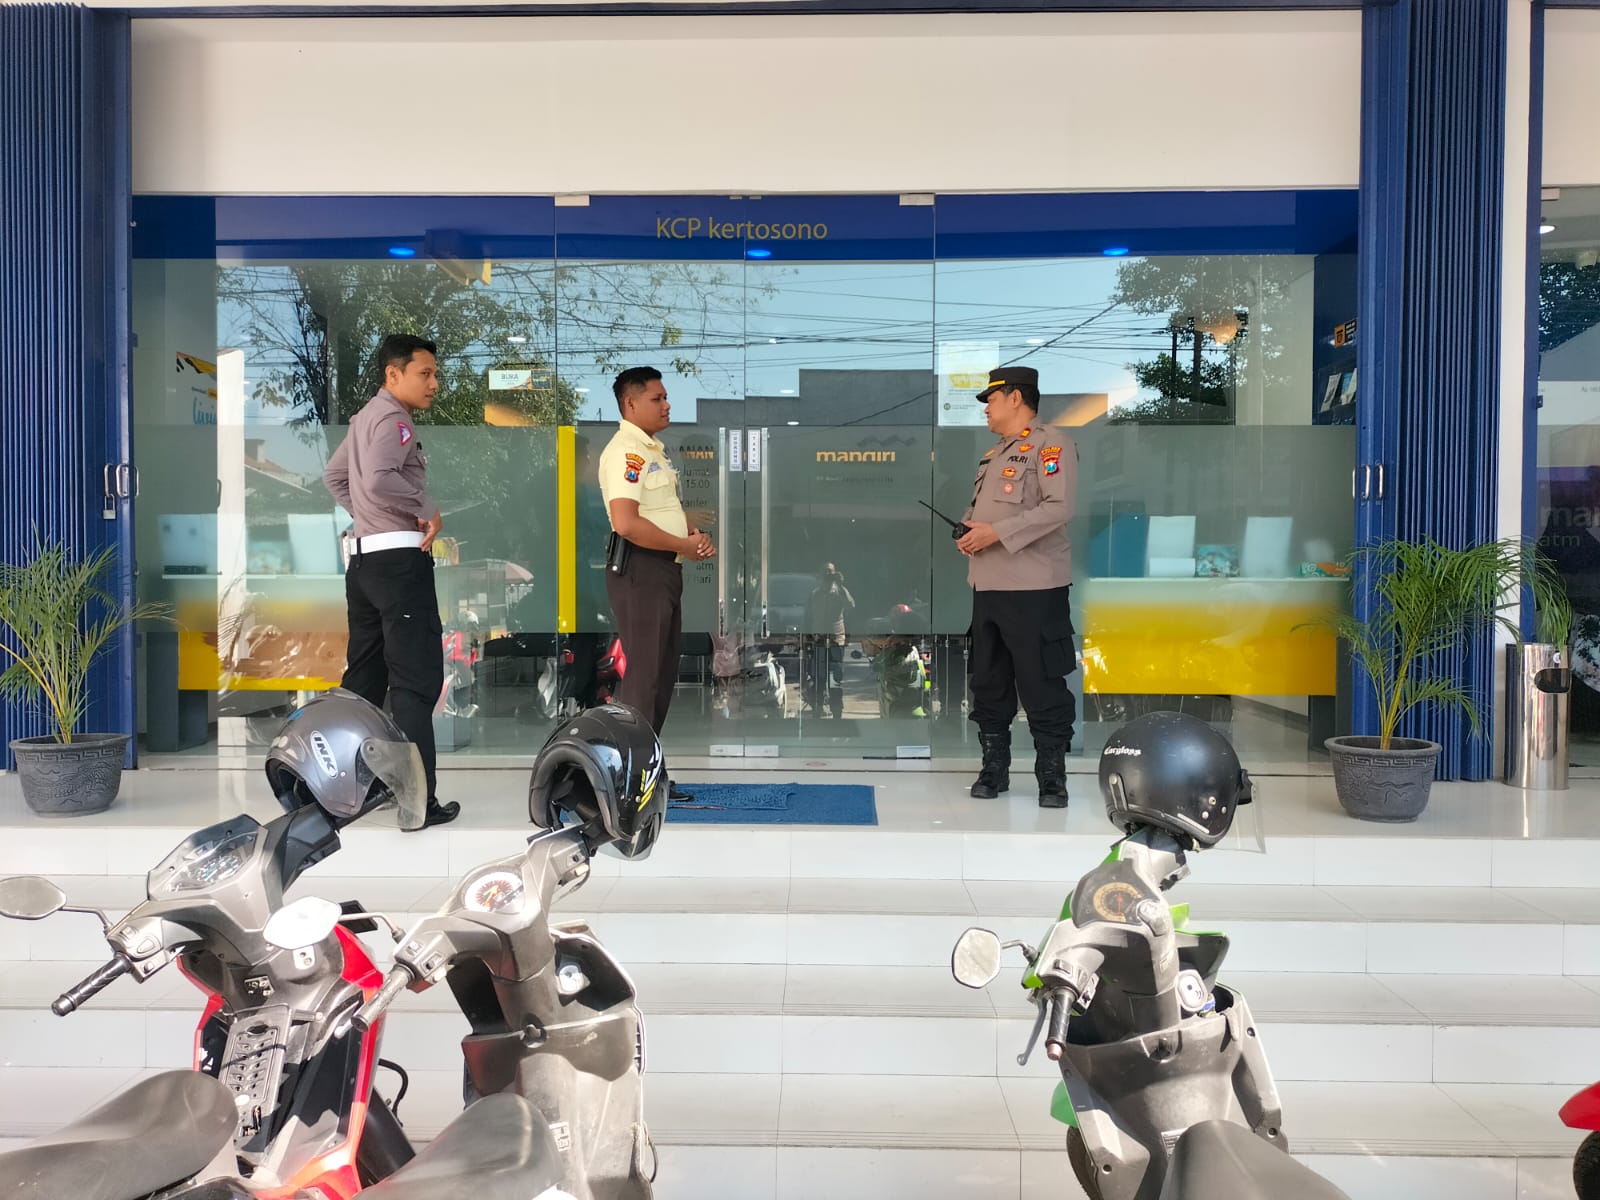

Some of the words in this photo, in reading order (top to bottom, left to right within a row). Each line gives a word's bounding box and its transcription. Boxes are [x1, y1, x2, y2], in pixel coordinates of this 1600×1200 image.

[657, 217, 701, 239] KCP
[708, 216, 828, 240] kertosono
[1008, 455, 1029, 464] POLRI
[1540, 533, 1581, 547] atm
[313, 736, 336, 771] INK
